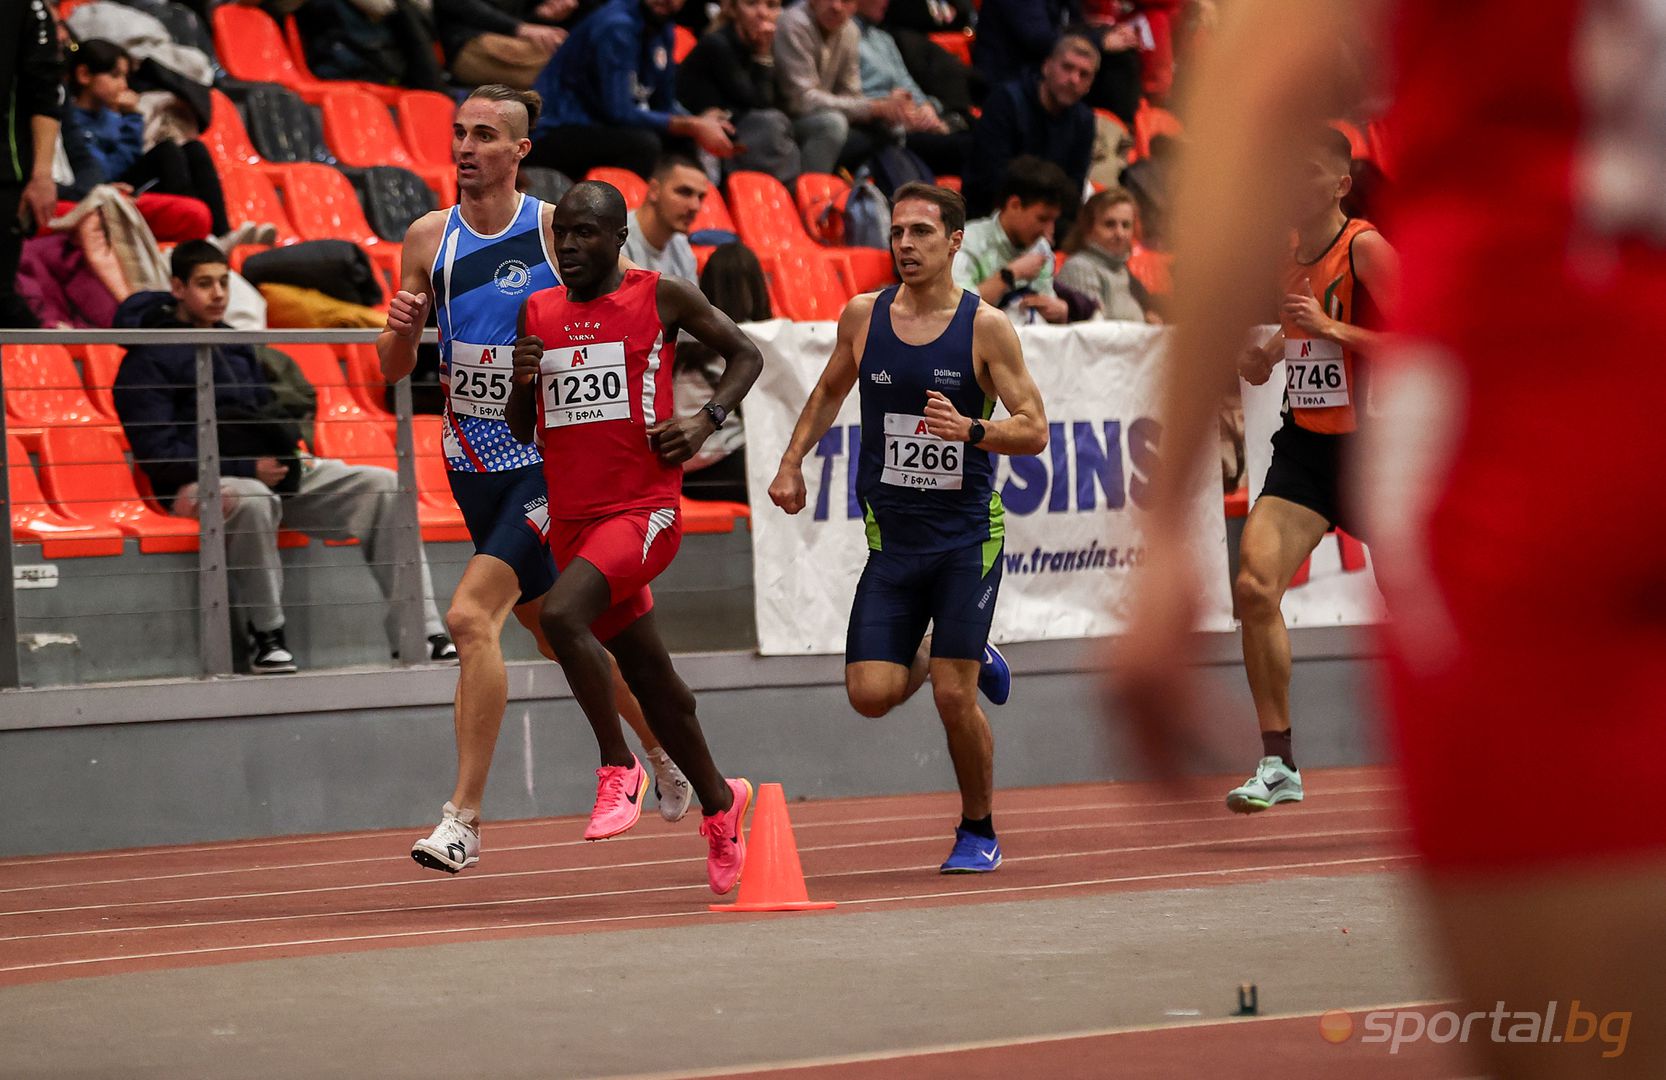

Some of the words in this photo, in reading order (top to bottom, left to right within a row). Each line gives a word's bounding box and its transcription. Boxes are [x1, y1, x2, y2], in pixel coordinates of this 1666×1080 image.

[564, 321, 601, 332] EVER
[454, 369, 514, 401] 255
[548, 371, 621, 406] 1230
[1287, 363, 1341, 390] 2746
[575, 409, 604, 420] БФЛА
[914, 419, 928, 435] A
[814, 417, 1165, 520] TSINS
[889, 440, 959, 471] 1266
[910, 476, 938, 486] БФЛА
